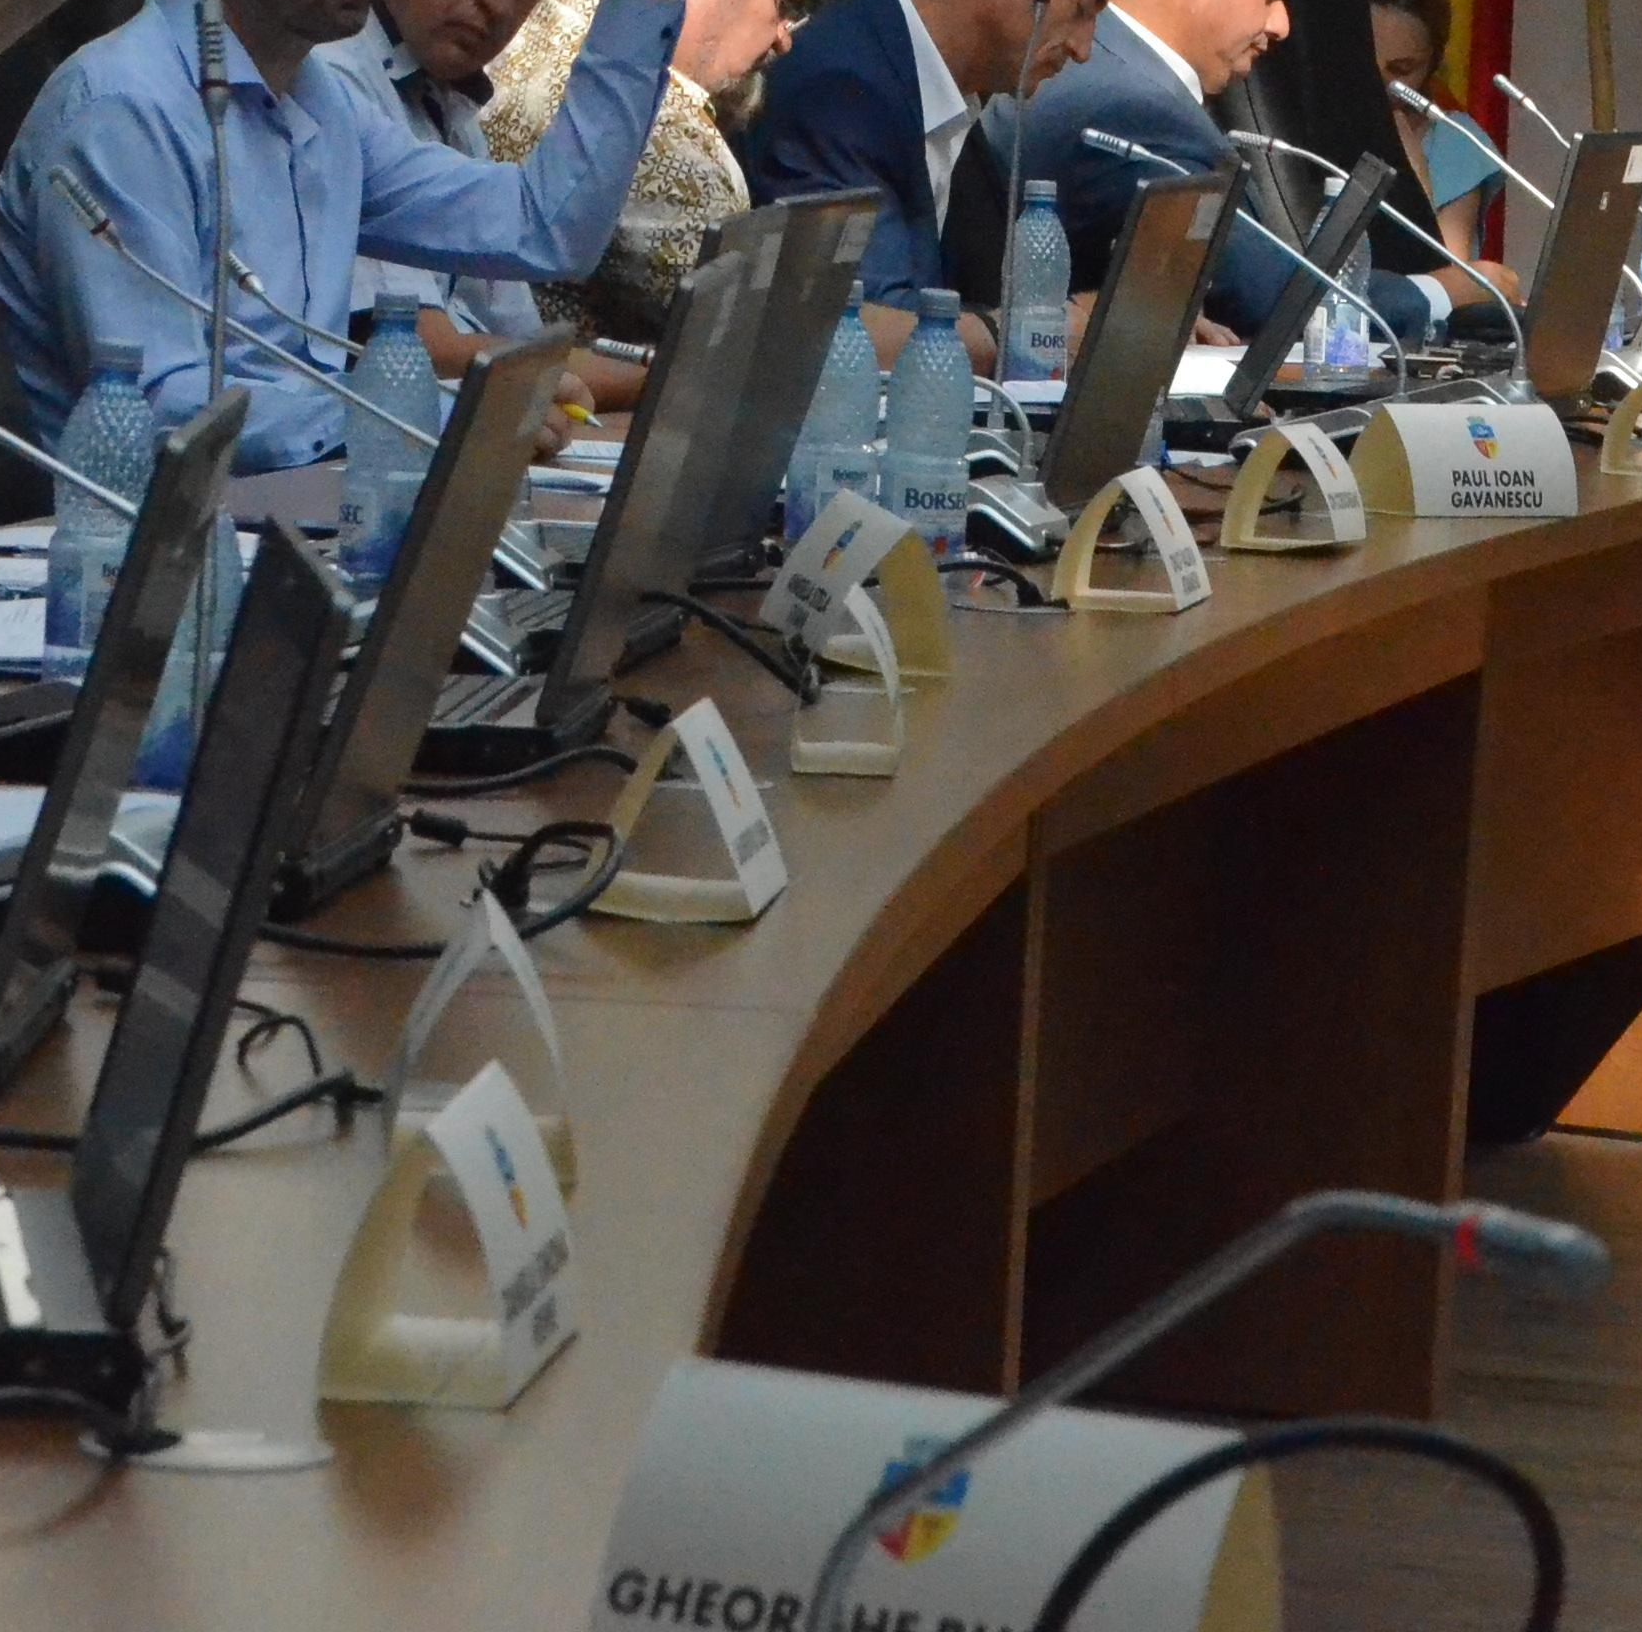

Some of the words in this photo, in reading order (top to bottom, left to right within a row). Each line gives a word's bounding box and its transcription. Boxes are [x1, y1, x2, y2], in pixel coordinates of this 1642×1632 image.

[1451, 470, 1490, 488] PAUL
[1494, 470, 1536, 488] IOAN
[1451, 491, 1543, 509] GAVANESCU
